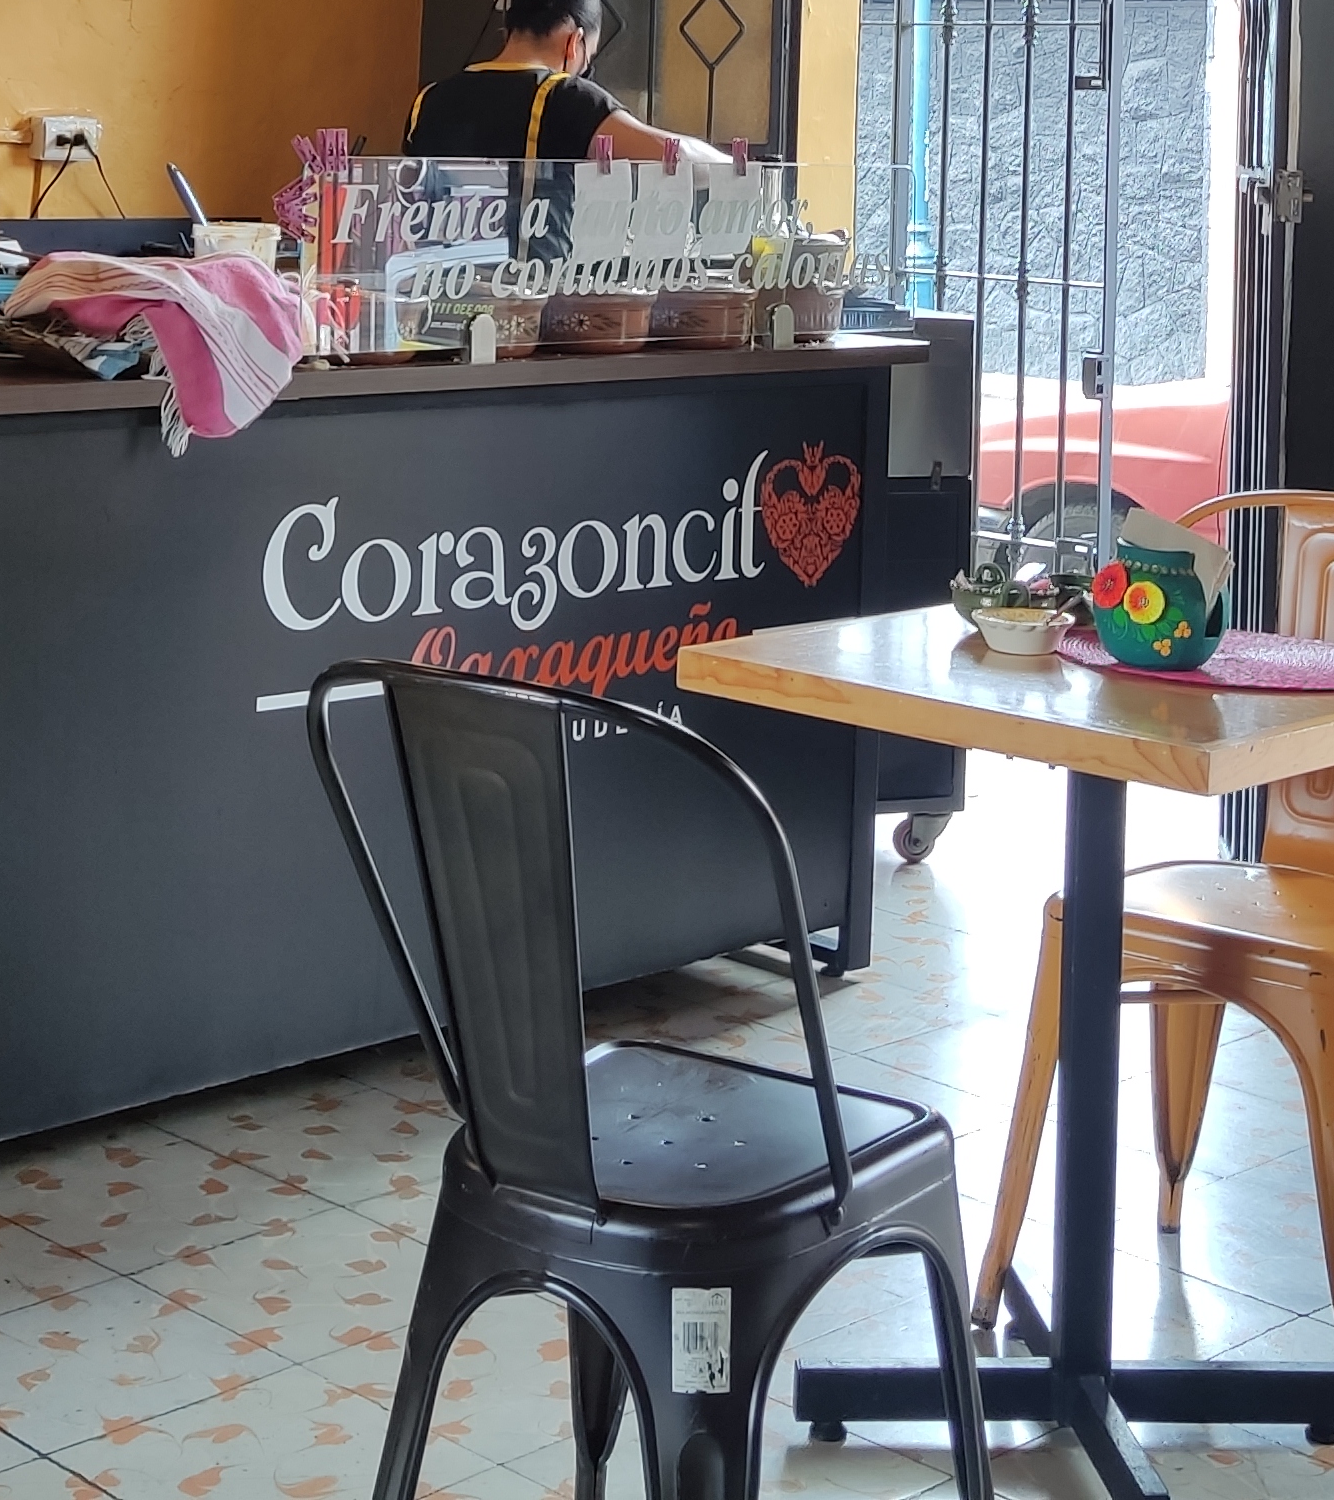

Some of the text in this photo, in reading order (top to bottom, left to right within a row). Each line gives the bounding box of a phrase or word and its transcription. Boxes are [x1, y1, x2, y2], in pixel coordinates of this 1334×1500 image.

[331, 184, 507, 244] Frente
[521, 197, 551, 239] a
[698, 197, 814, 235] amor,
[411, 259, 476, 300] no
[491, 250, 710, 299] contamos
